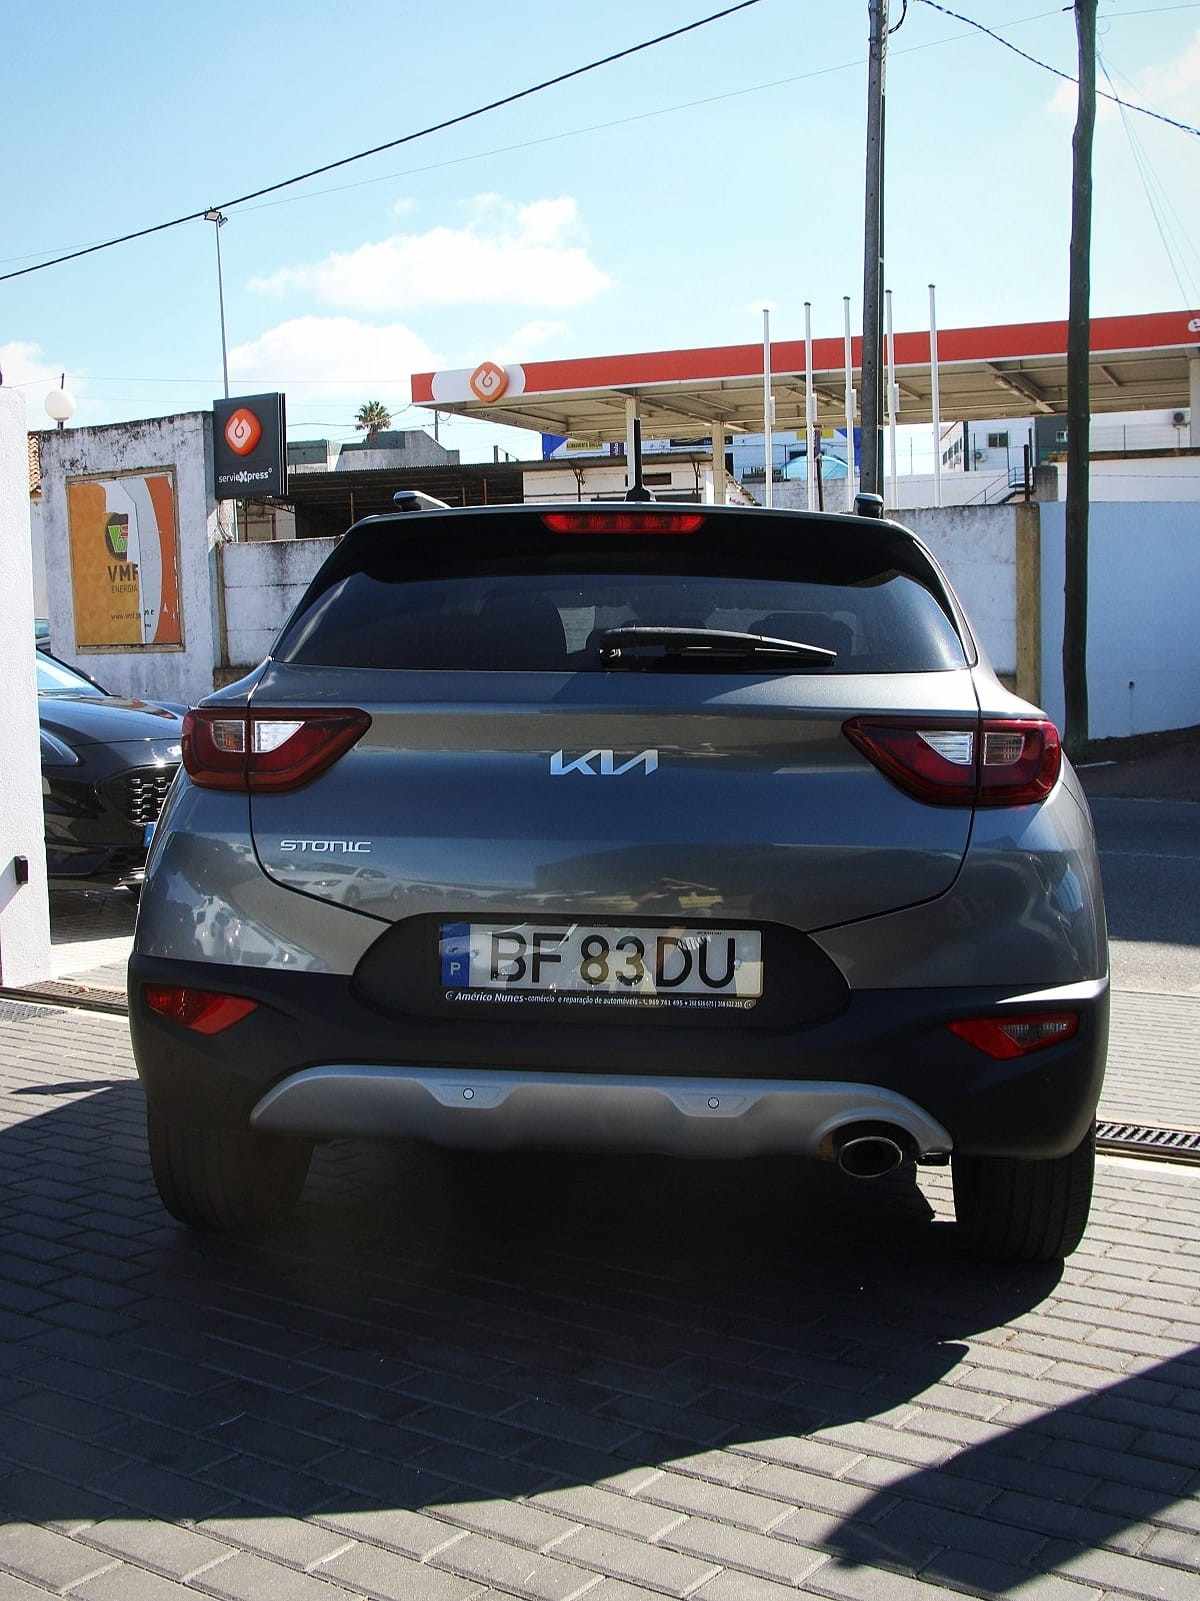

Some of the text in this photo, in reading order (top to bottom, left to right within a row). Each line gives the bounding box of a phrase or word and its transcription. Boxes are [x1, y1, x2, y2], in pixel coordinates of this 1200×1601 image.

[550, 749, 658, 775] KIA
[280, 840, 371, 853] STONIC
[490, 931, 736, 989] BF 83 DU
[450, 961, 461, 977] P
[455, 991, 492, 1001] Américo
